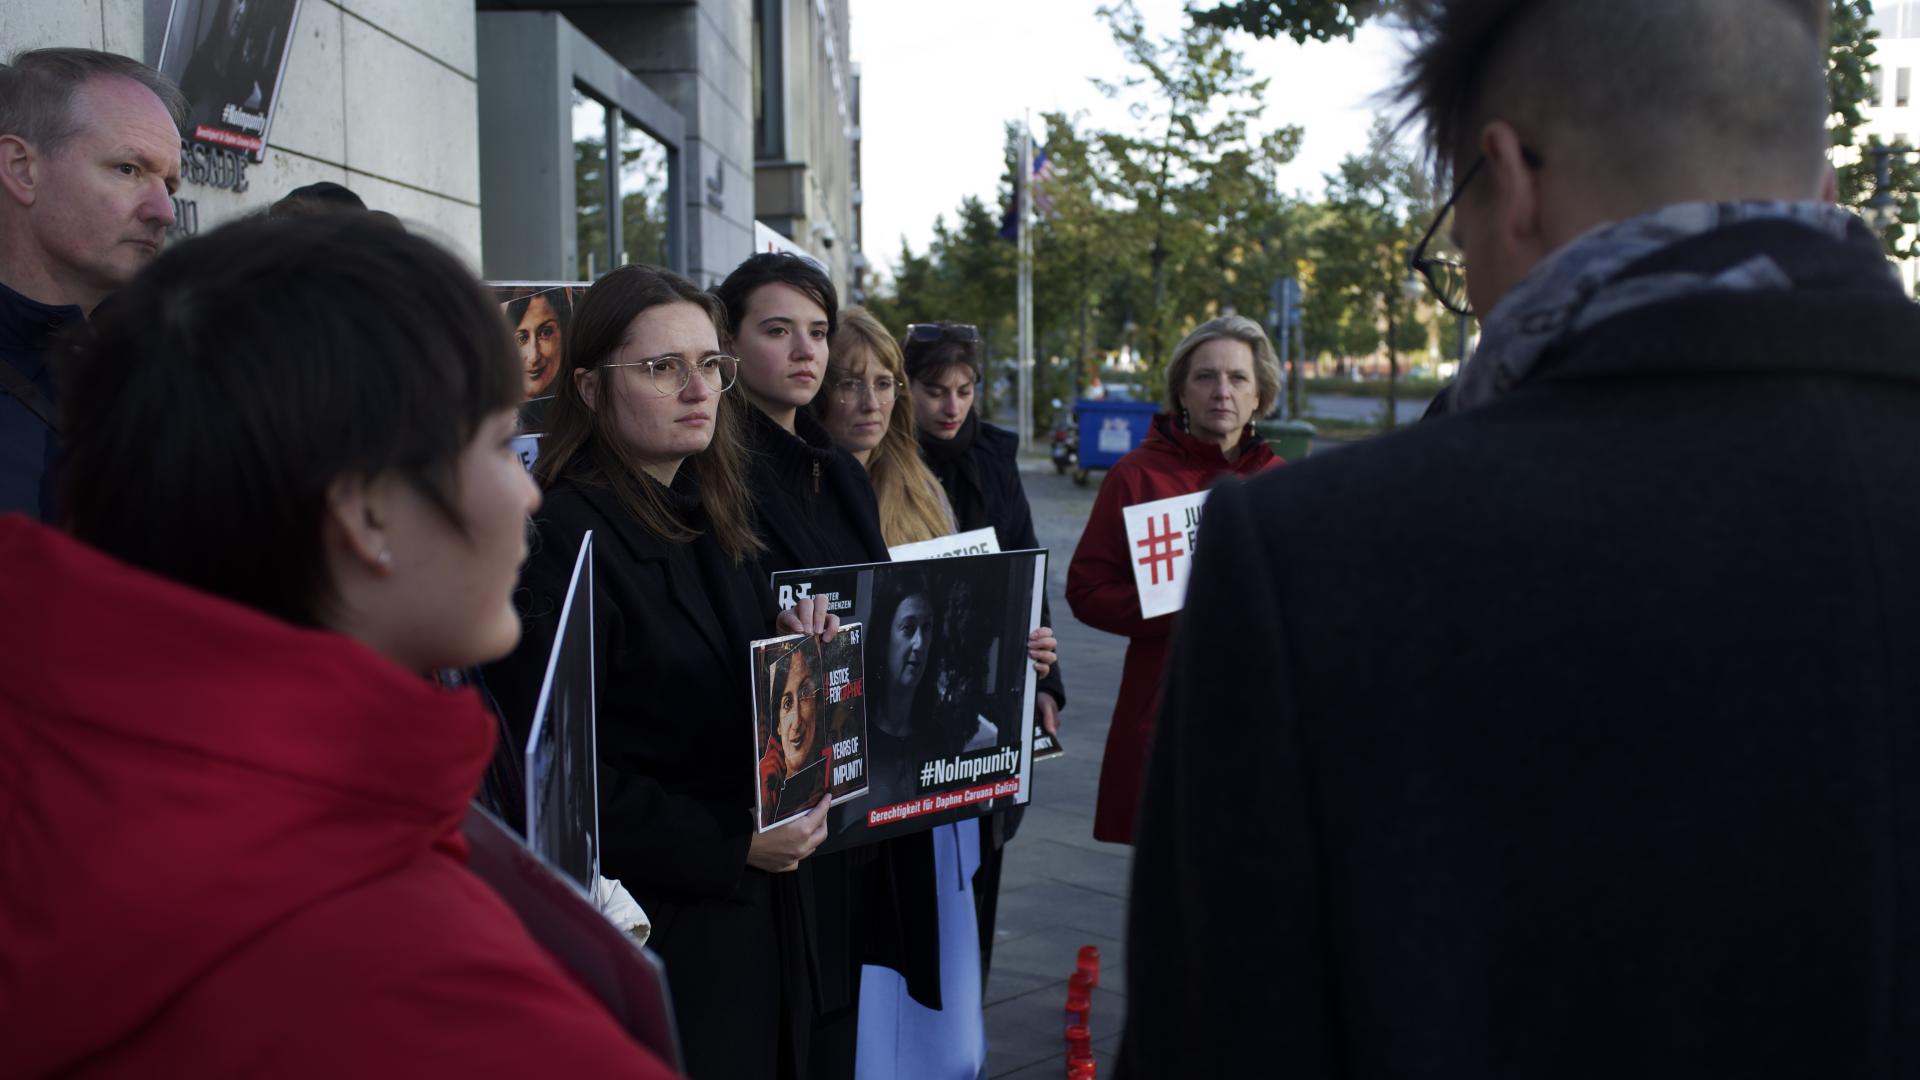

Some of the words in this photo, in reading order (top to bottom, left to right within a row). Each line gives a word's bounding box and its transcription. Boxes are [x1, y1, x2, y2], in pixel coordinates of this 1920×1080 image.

[832, 740, 852, 760] YEARS
[851, 736, 859, 754] OF
[833, 758, 863, 786] IMPUNITY
[920, 746, 1019, 787] #NoImpunity
[870, 801, 920, 823] Gerechtigkeit
[923, 798, 934, 811] für
[935, 794, 963, 809] Daphne
[964, 787, 993, 802] Caruana
[994, 780, 1018, 795] Galizia
